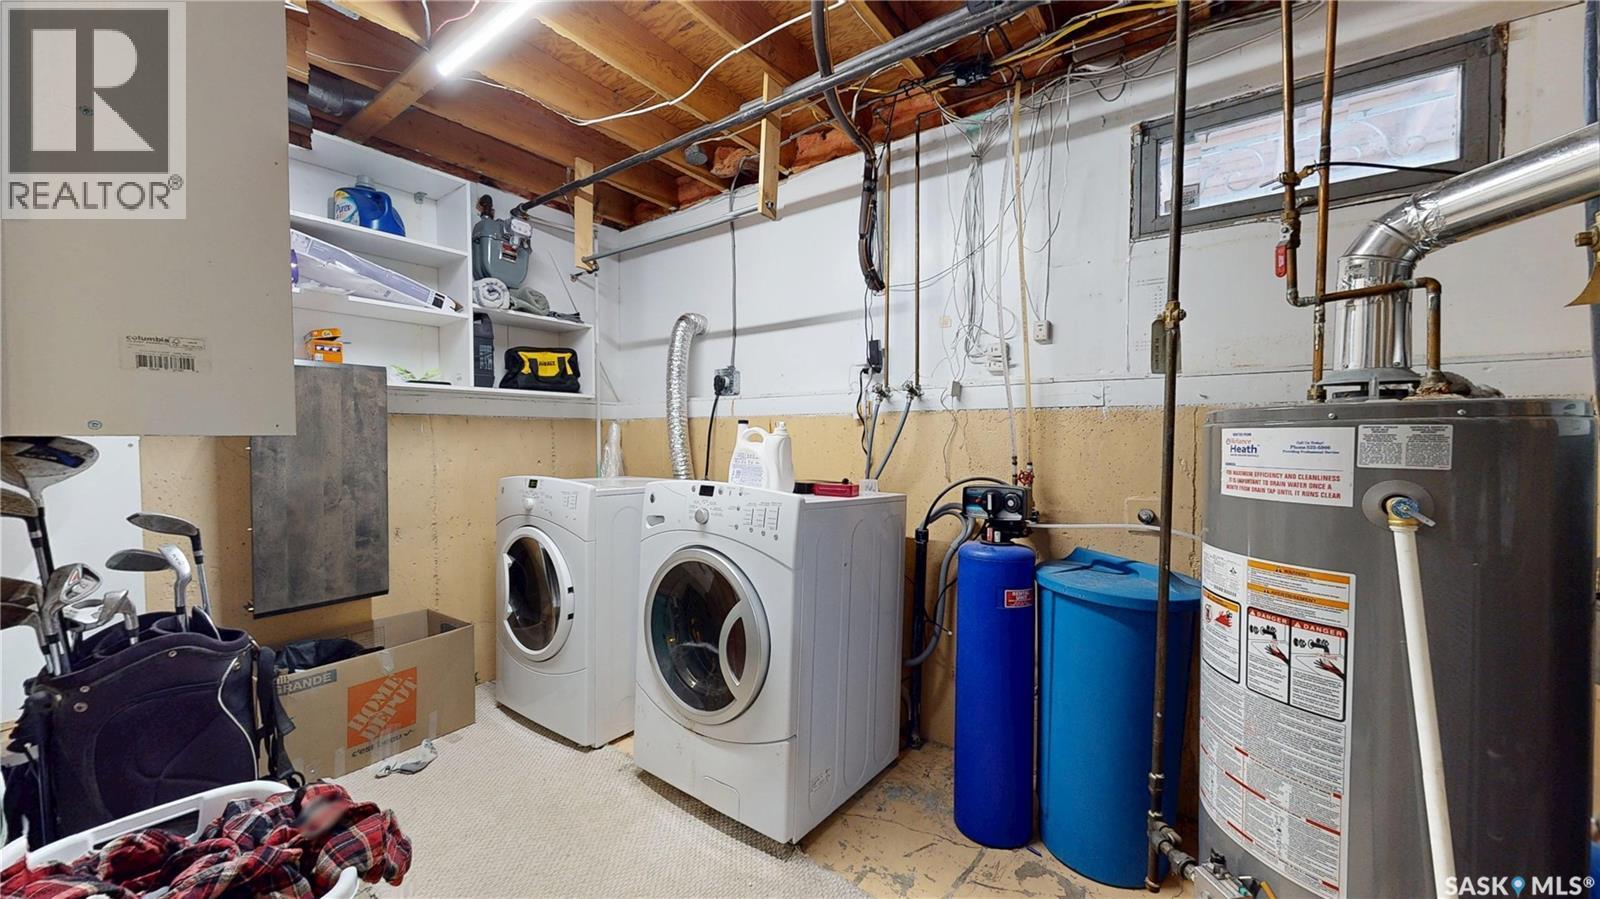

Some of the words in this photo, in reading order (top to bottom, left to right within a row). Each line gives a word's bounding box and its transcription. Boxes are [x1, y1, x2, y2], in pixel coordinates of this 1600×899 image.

[1230, 444, 1258, 454] Heath
[1254, 471, 1284, 479] EFFICIENCY
[1298, 474, 1341, 482] CLEANLINESS
[1308, 482, 1326, 490] ONCE
[1277, 488, 1293, 496] UNTIL
[1320, 491, 1341, 499] CLEAR
[1256, 611, 1288, 624] DANGER
[1303, 624, 1343, 637] DANGER
[348, 675, 404, 732] HOME
[360, 676, 417, 739] DEPOT
